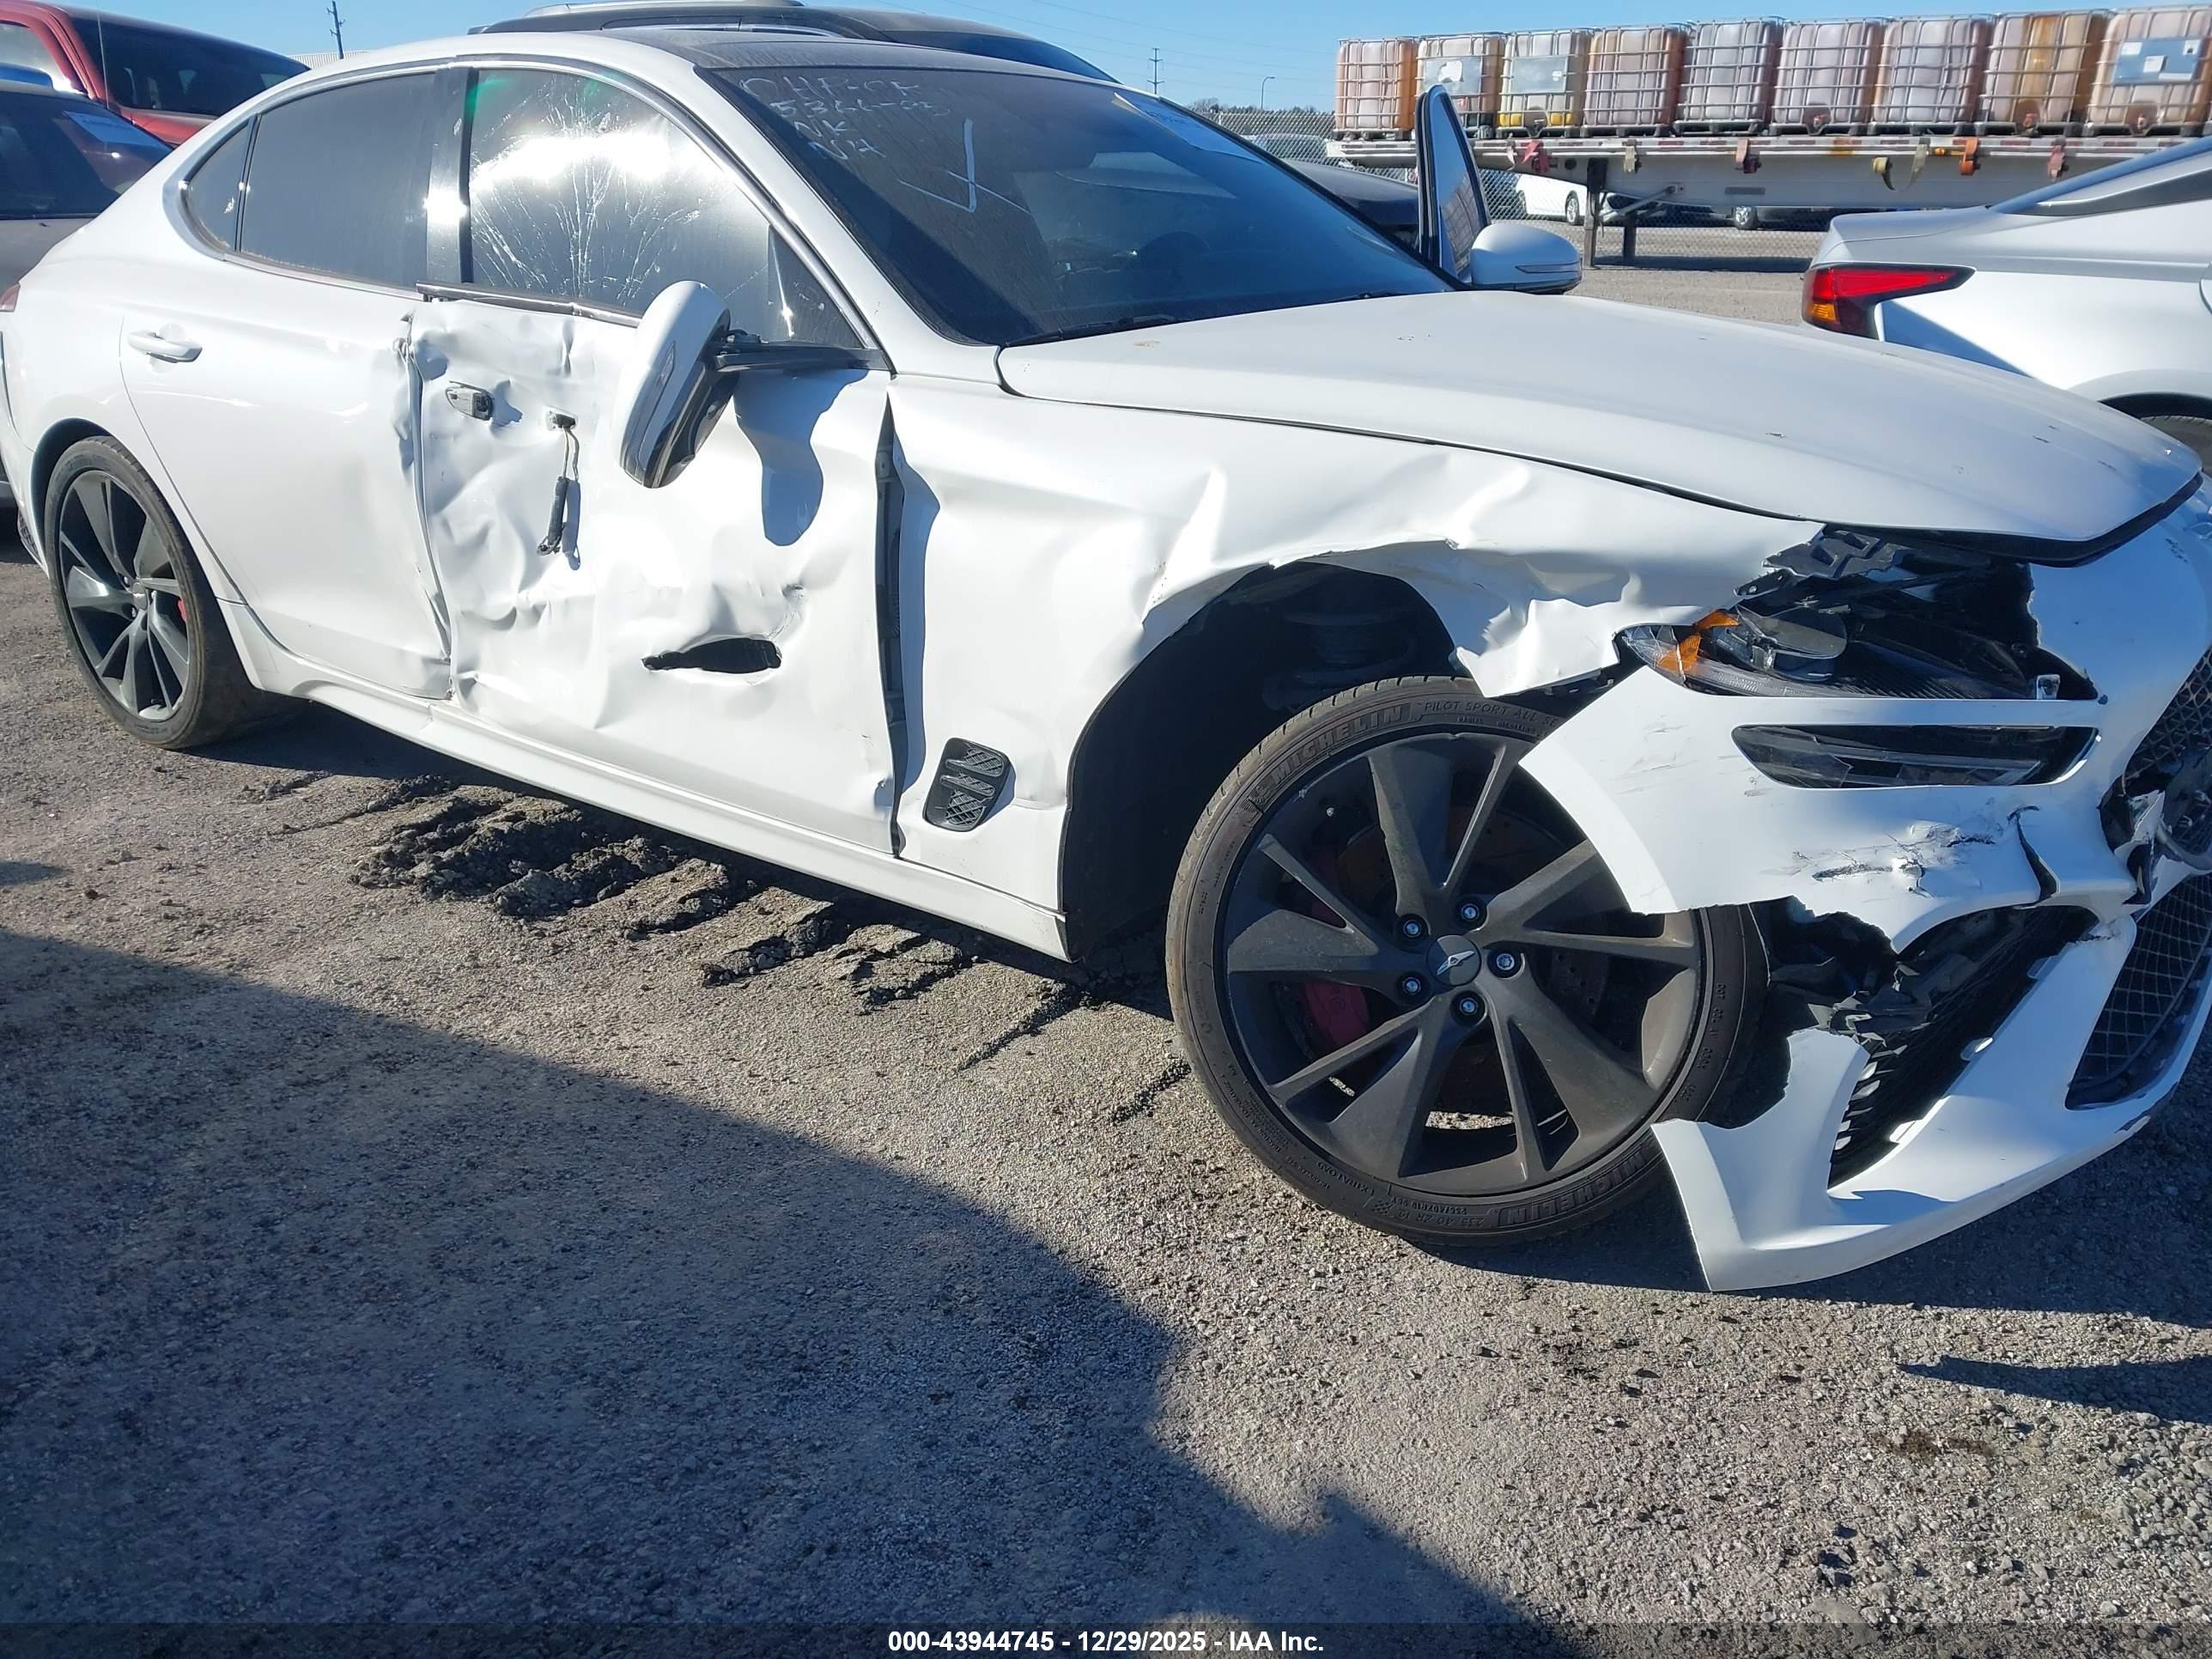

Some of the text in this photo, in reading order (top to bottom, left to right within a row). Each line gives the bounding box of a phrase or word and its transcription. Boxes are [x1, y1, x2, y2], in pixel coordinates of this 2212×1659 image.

[1271, 704, 1403, 786] MICHELIN
[1425, 700, 1461, 713] PILOT
[1465, 701, 1511, 715] SPORT
[1513, 708, 1539, 723] ALL
[1504, 1150, 1644, 1226] MICHELIN
